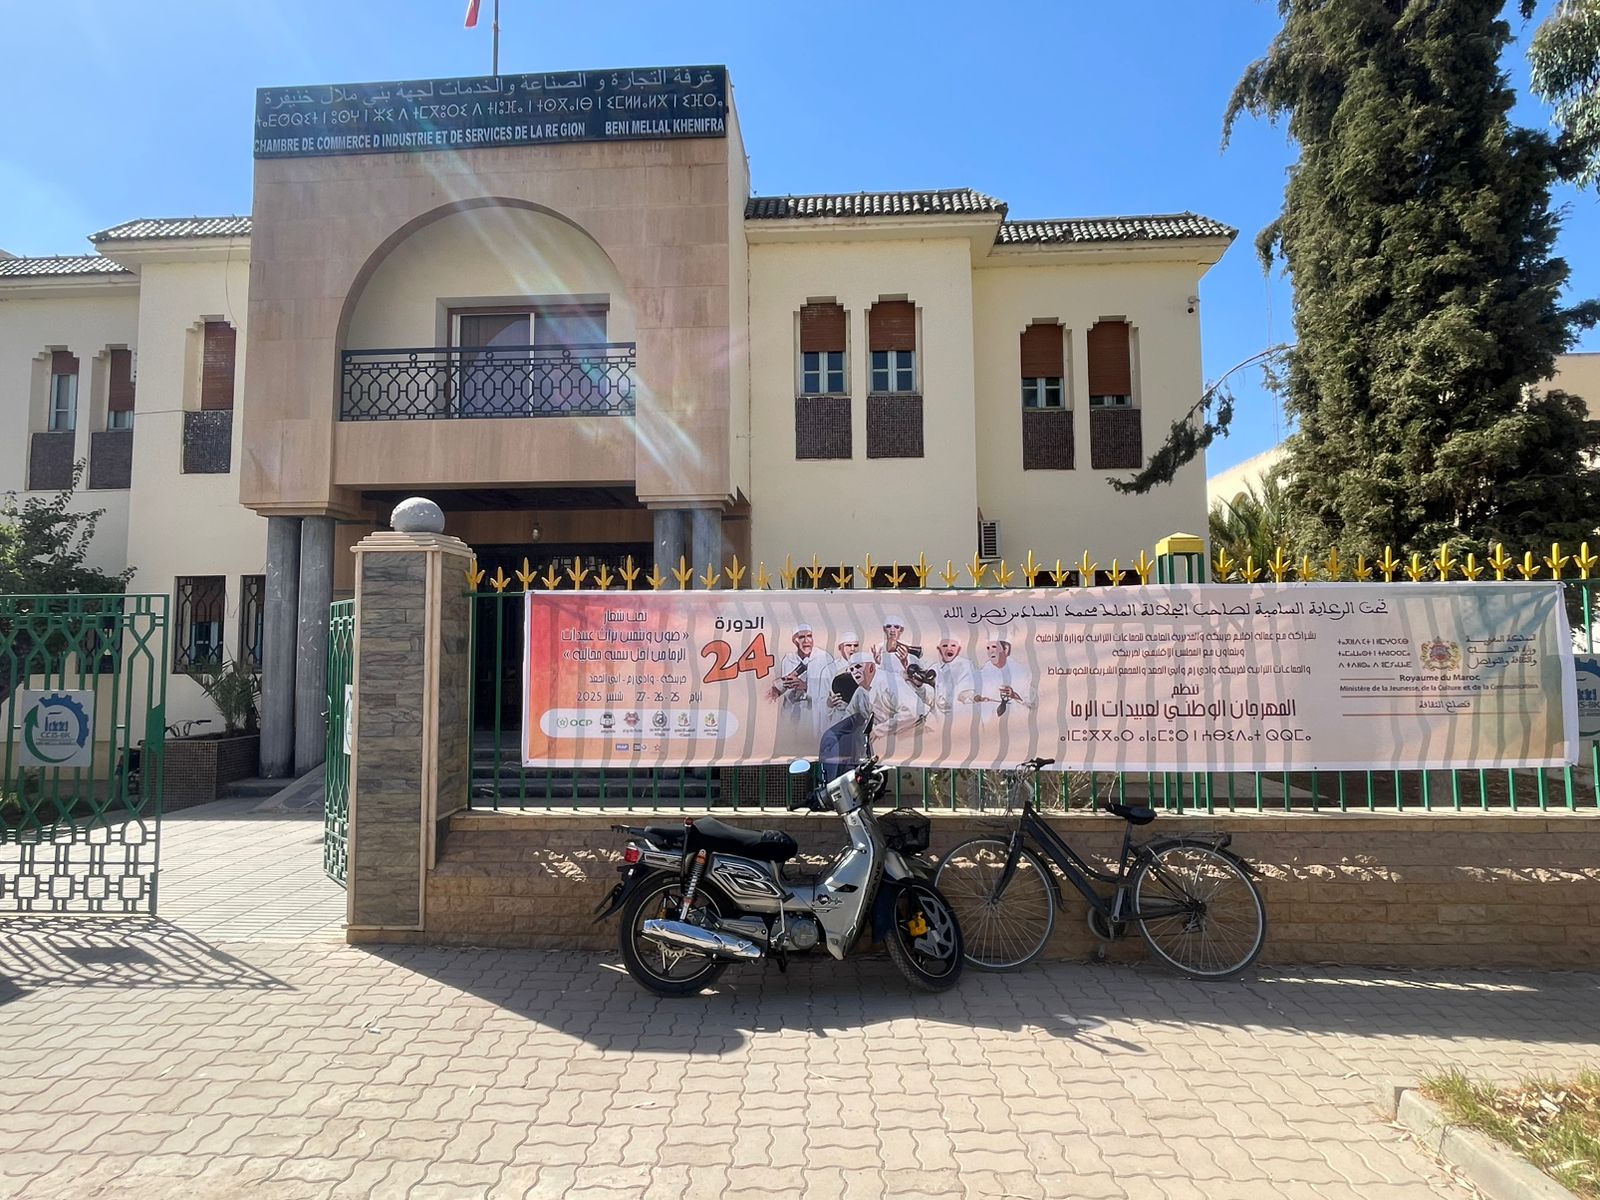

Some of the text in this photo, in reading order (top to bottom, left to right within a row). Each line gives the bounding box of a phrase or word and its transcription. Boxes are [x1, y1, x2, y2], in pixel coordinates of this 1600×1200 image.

[521, 72, 586, 92] الصناعة
[611, 69, 667, 90] التجارة
[673, 67, 715, 88] غرفة
[264, 89, 314, 110] خنيفرة
[320, 86, 358, 105] ملال
[363, 86, 391, 106] بني
[396, 81, 434, 102] لجهة
[254, 137, 299, 153] CHAMBRE
[302, 137, 314, 151] DE
[316, 135, 371, 150] COMMERCE
[373, 134, 380, 148] D
[382, 131, 433, 147] INDUSTRIE
[435, 131, 448, 145] ET
[450, 129, 463, 144] DE
[465, 126, 512, 143] SERVICES
[514, 125, 527, 140] DE
[530, 124, 543, 138] LA
[605, 120, 629, 135] BENI
[631, 119, 671, 134] MELLAL
[673, 117, 724, 133] KHENIFRA
[943, 606, 964, 619] الله
[1064, 605, 1098, 617] محمد
[1140, 602, 1188, 619] الجلالة
[1193, 602, 1250, 618] لصاحب
[1255, 602, 1304, 618] السامية
[1309, 601, 1354, 621] الرعاية
[1359, 599, 1389, 615] تحت
[715, 616, 764, 633] الدورة
[700, 632, 775, 684] 24
[1399, 674, 1439, 682] Royaume
[577, 691, 602, 702] 2025
[1171, 683, 1200, 699] تنظم
[1070, 699, 1296, 723] المهرجان الوطني لعبيدات الرما
[570, 719, 593, 727] OCP
